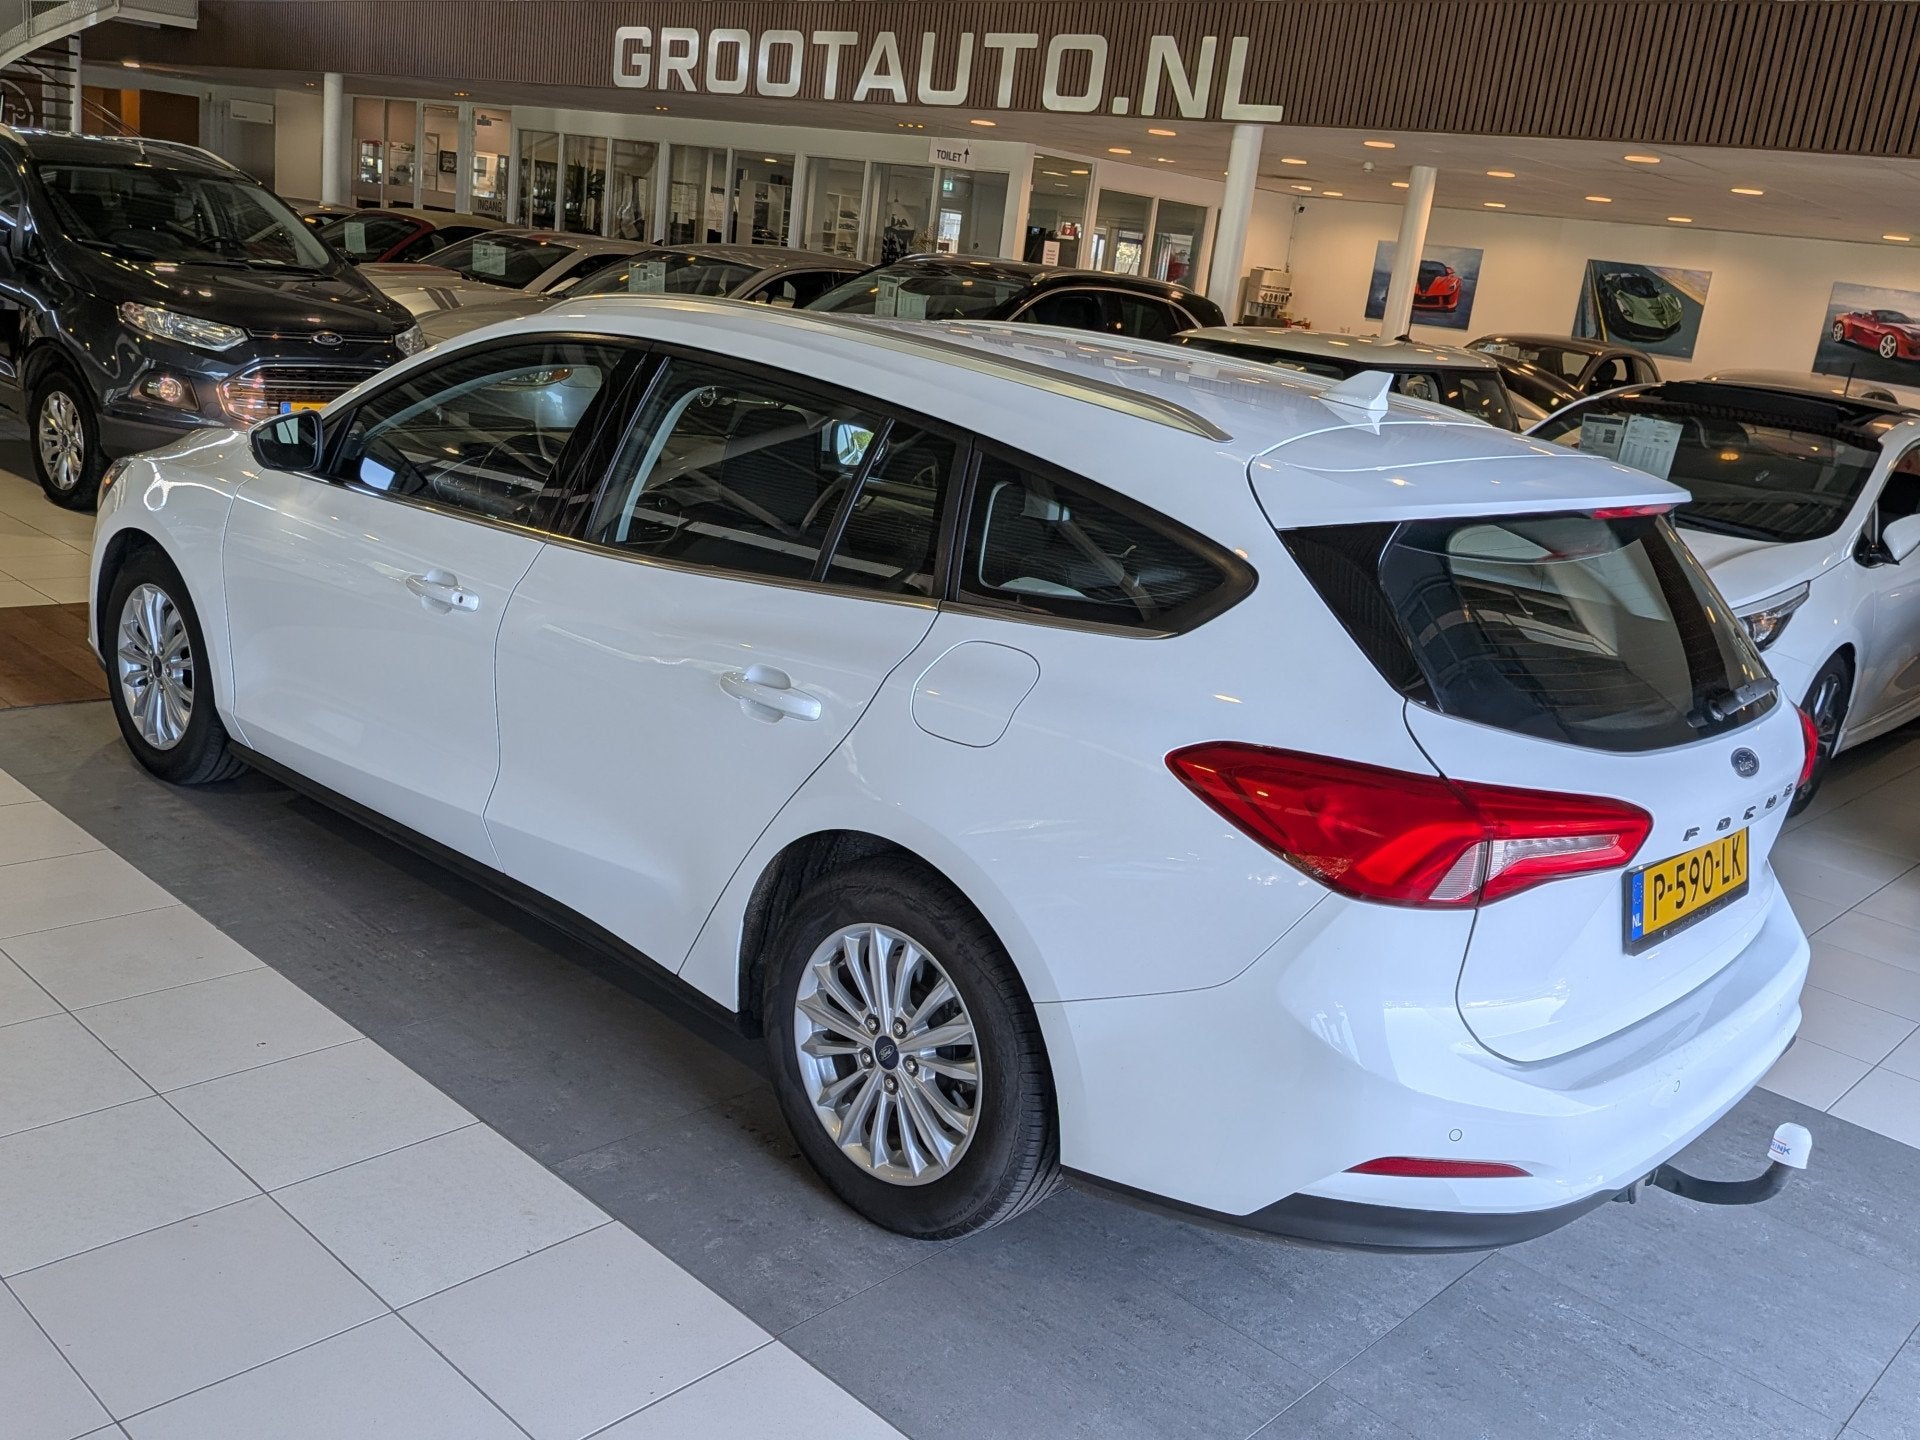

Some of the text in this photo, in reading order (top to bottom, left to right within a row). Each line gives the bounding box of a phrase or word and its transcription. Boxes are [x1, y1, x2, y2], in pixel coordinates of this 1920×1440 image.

[613, 26, 1284, 122] GROOTAUTO.NL
[936, 149, 962, 162] TOILET
[1683, 783, 1793, 841] FOCUS
[1653, 834, 1741, 921] P-590-LK
[1632, 912, 1642, 928] NL
[1770, 1141, 1792, 1155] RINK
